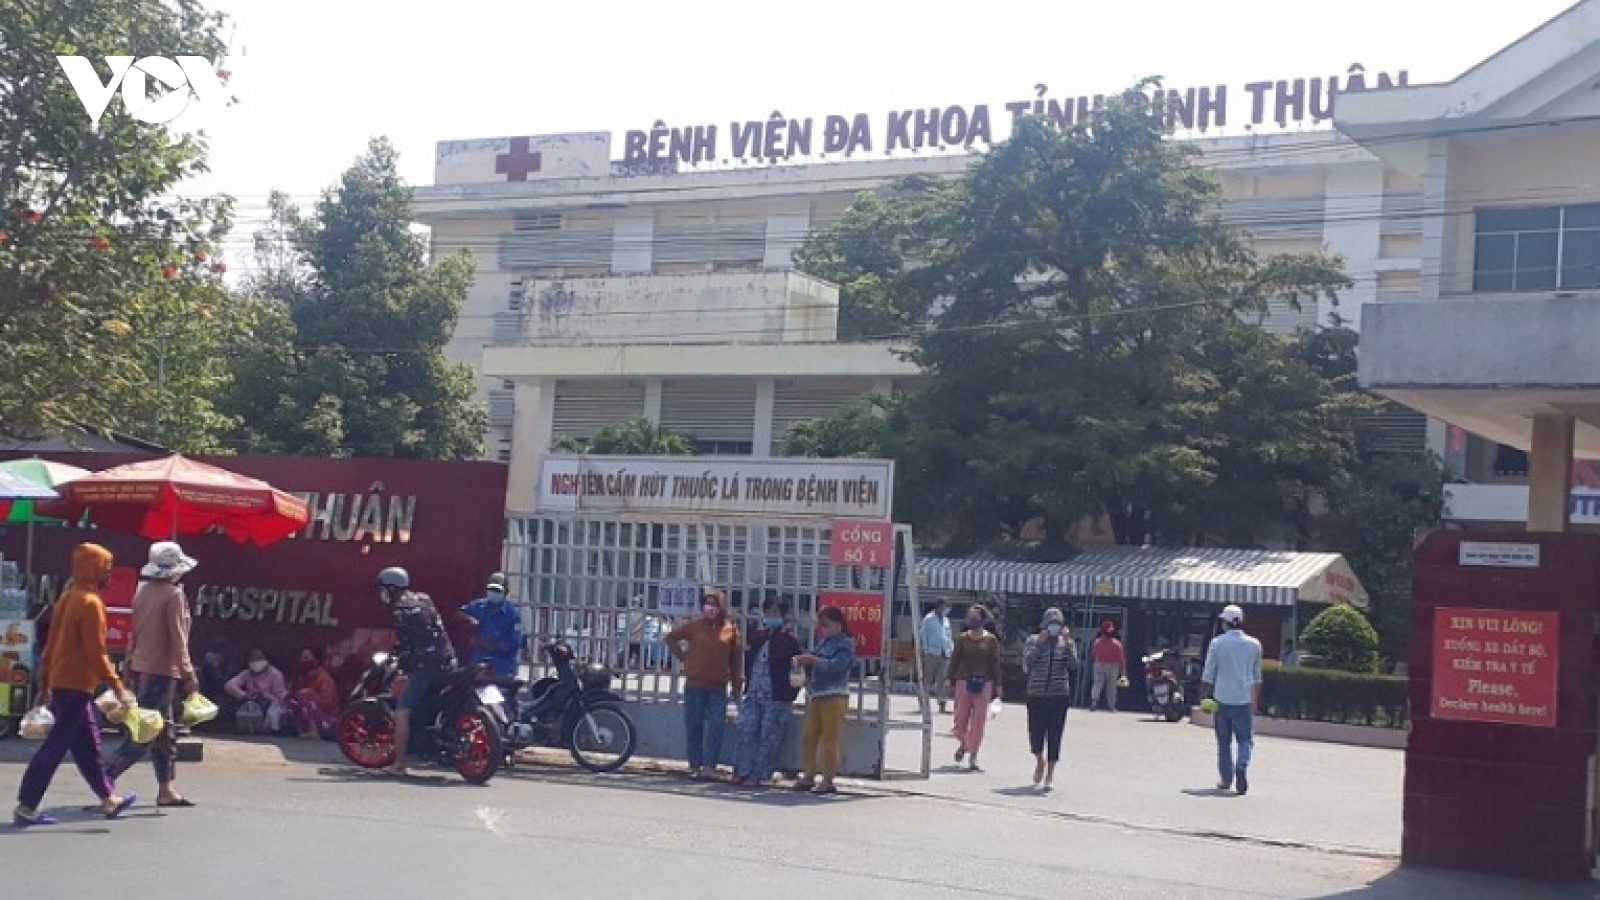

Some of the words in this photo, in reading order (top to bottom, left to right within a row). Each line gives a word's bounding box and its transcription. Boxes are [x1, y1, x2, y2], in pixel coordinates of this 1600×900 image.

[824, 112, 872, 154] ĐA
[887, 104, 991, 150] KHOA
[639, 470, 668, 497] HÚT
[671, 469, 718, 500] THUỐC
[720, 470, 739, 499] LÁ
[746, 476, 793, 501] TRONG
[796, 473, 838, 507] BỆNH
[842, 475, 879, 509] VIỆN
[195, 584, 339, 627] HOSPITAL
[1478, 618, 1499, 633] VUI
[1481, 700, 1517, 715] health
